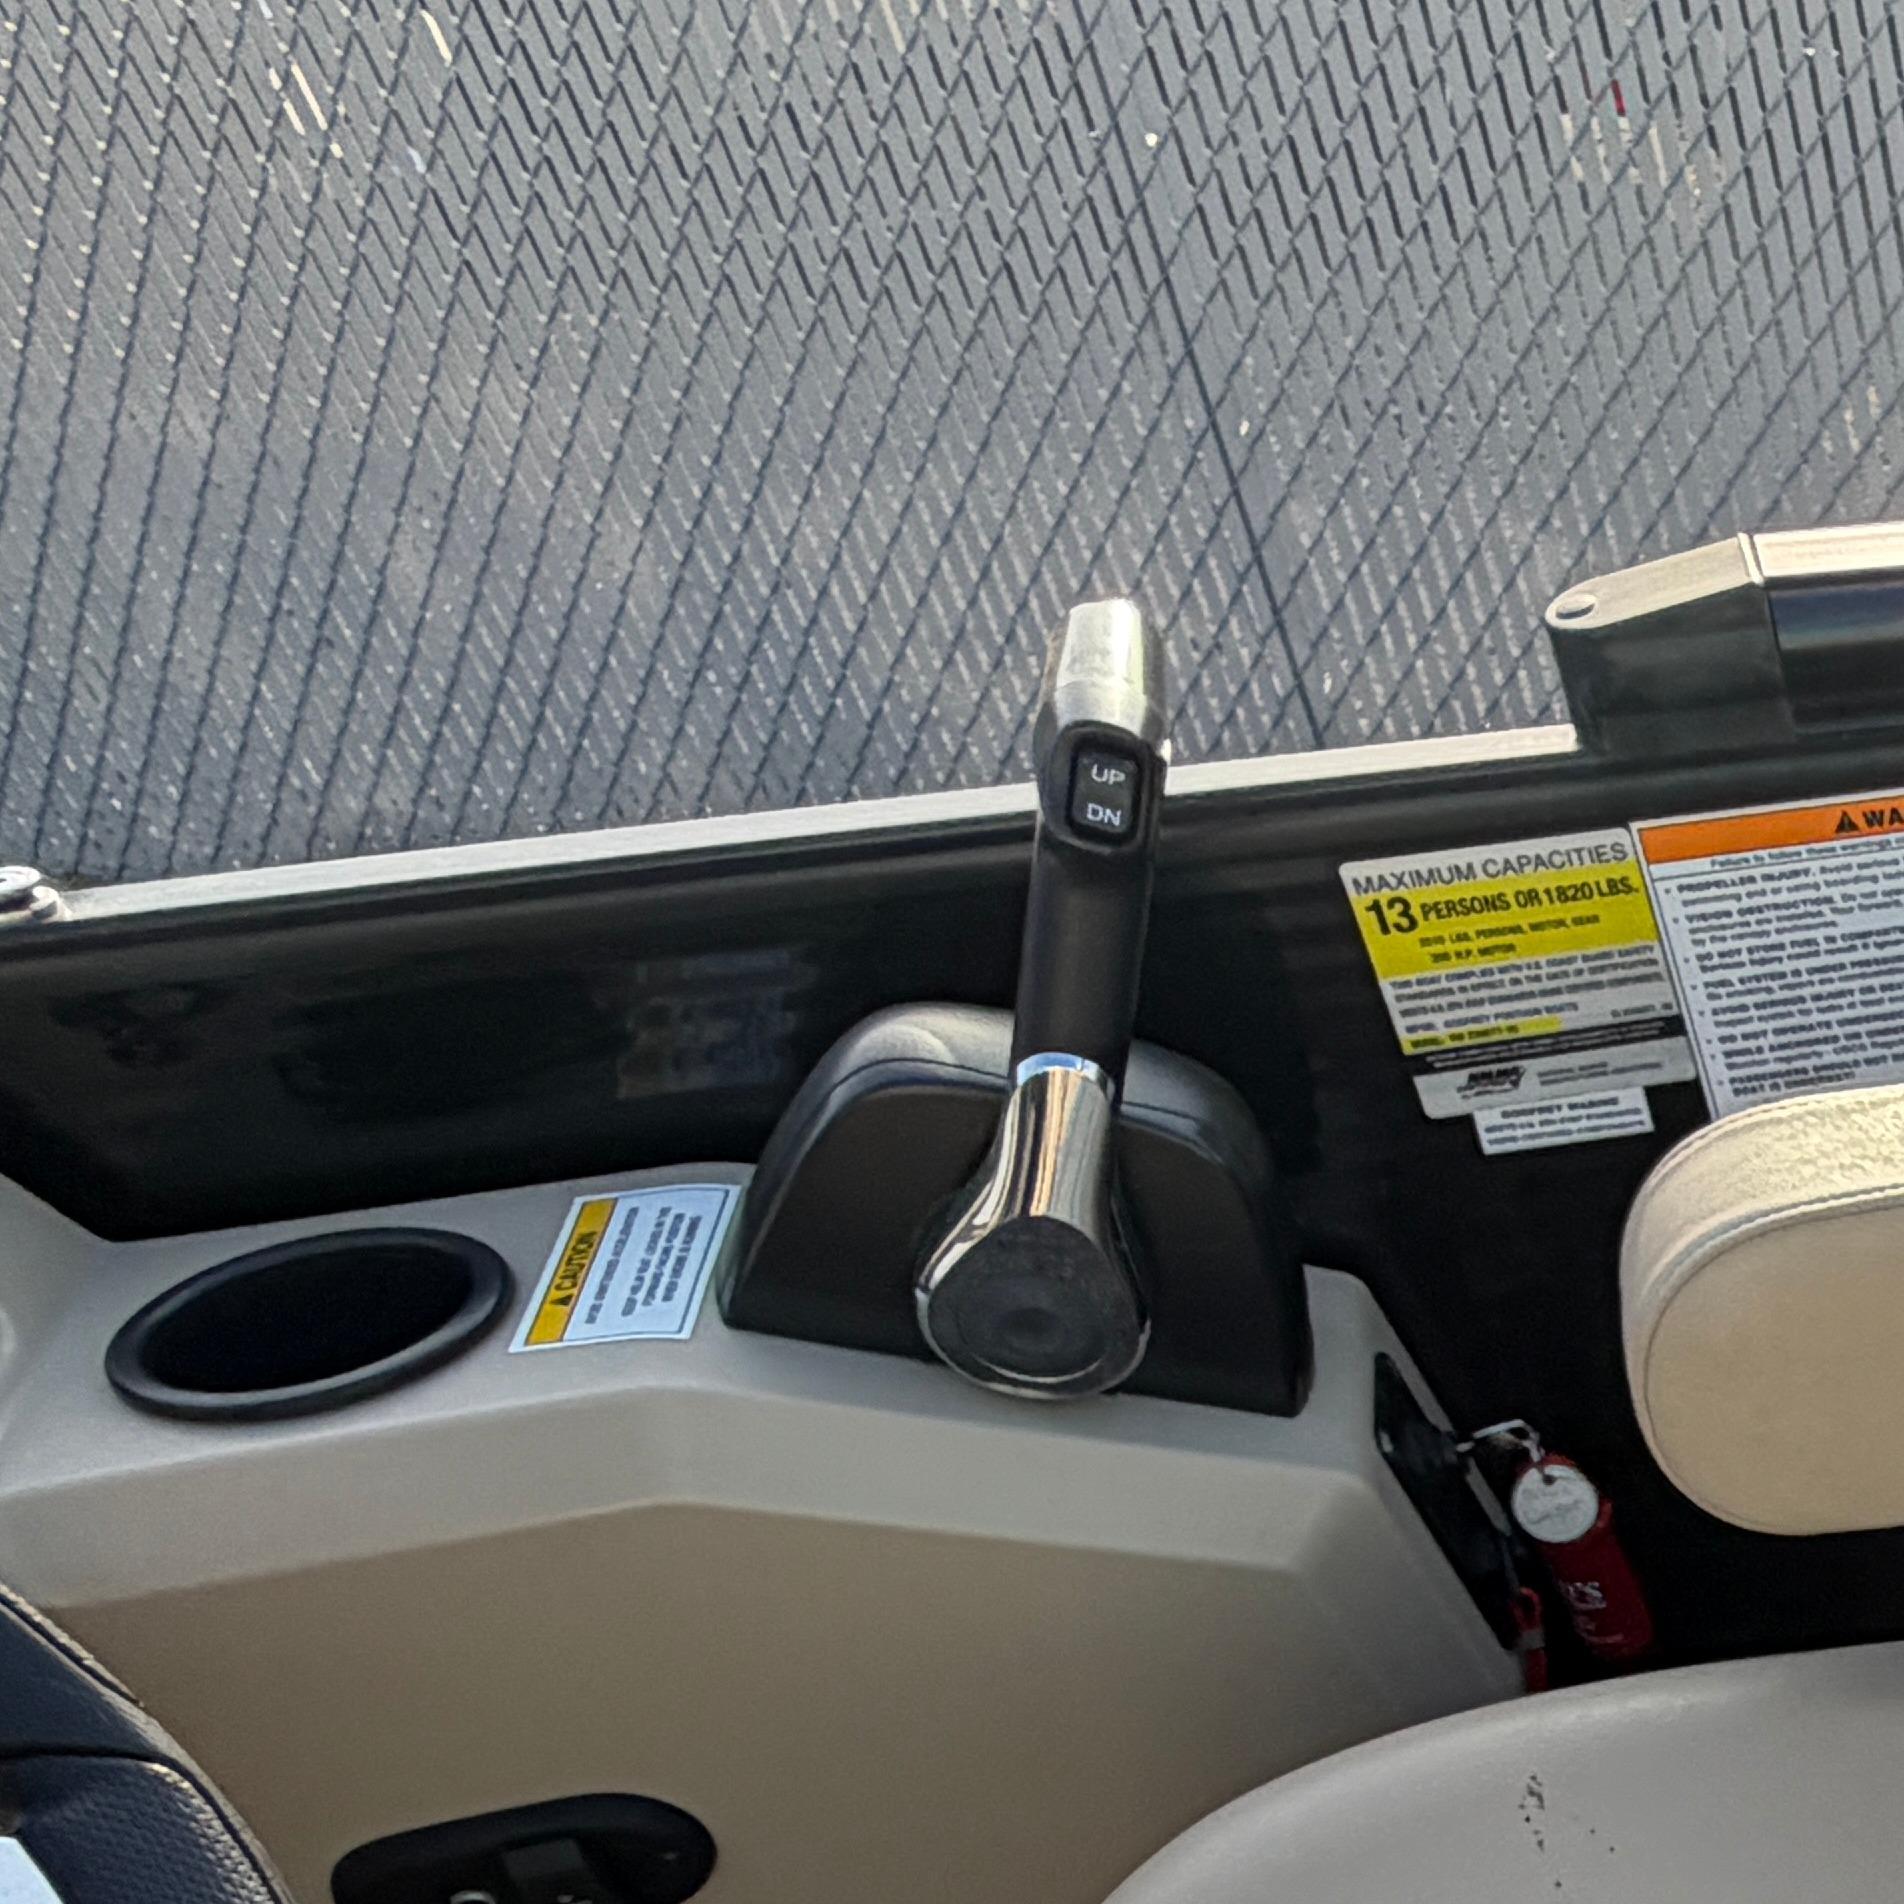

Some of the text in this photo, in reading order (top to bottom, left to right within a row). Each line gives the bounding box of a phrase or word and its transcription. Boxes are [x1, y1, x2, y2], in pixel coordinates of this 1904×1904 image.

[1090, 763, 1126, 785] UP
[1086, 802, 1122, 827] DN
[1350, 841, 1630, 895] MAXIMUM CAPACITIES
[1361, 874, 1639, 937] 13 PERSONS OR 1820 LBS.
[555, 1231, 598, 1291] CAUTION
